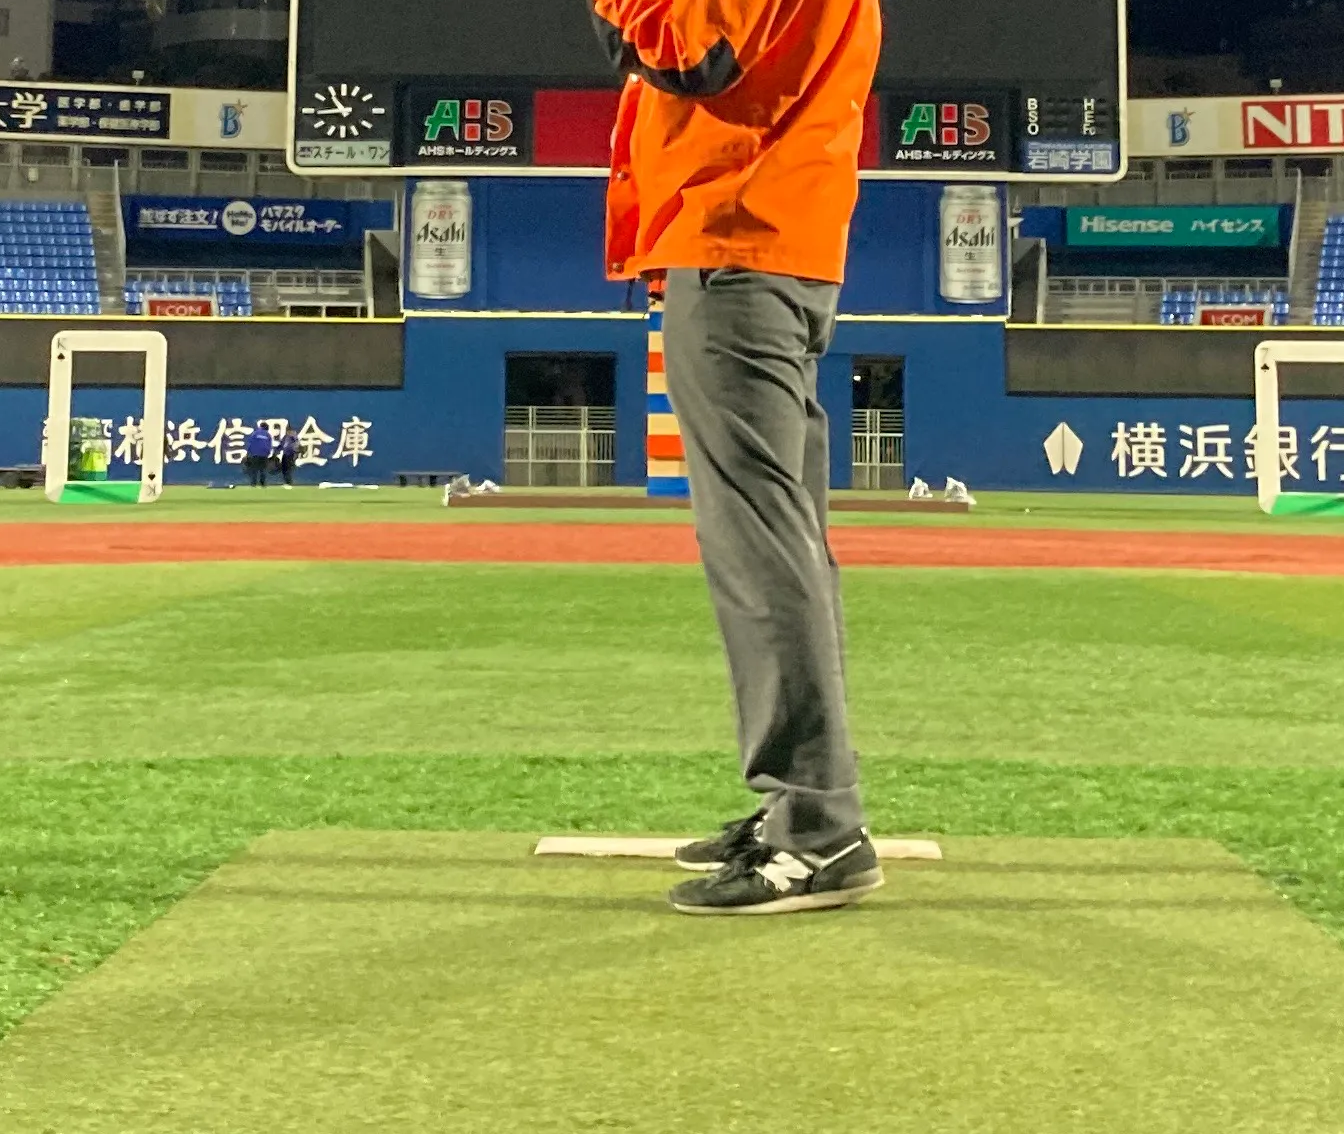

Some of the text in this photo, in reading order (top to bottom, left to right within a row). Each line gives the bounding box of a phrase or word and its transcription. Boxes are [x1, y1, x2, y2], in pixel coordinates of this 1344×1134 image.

[418, 145, 518, 157] AHSホールディングス
[895, 150, 996, 162] AHSホールディングス
[1027, 149, 1113, 170] 岩崎学園
[416, 221, 465, 243] Asahi
[1081, 216, 1174, 234] Hisense
[1190, 217, 1265, 233] ハイセンス
[945, 226, 995, 247] Asahi
